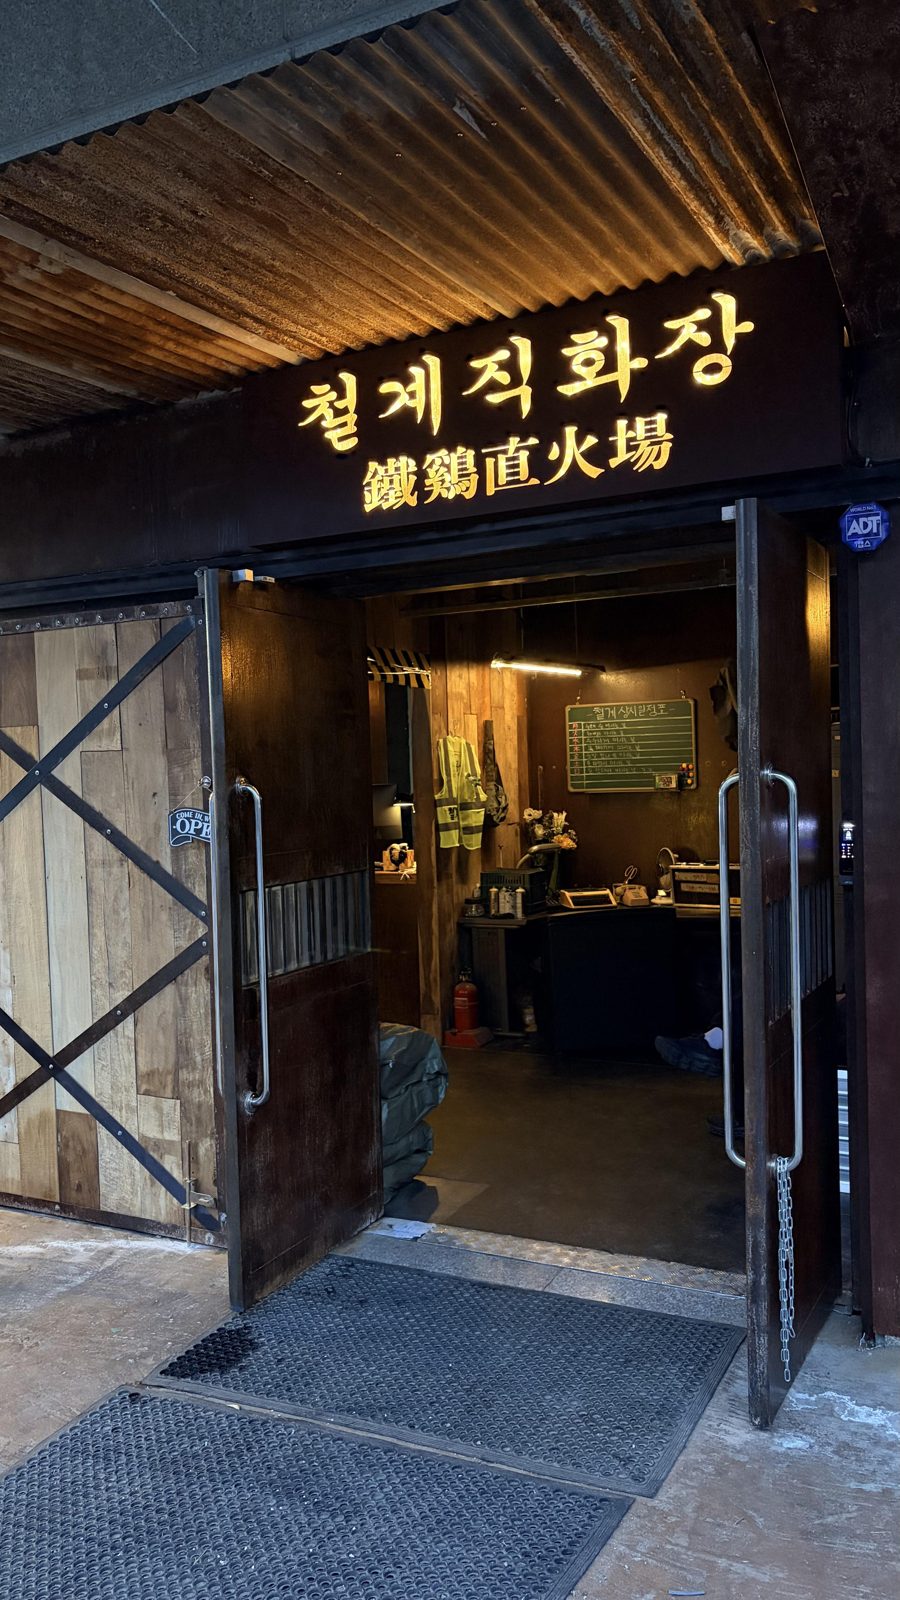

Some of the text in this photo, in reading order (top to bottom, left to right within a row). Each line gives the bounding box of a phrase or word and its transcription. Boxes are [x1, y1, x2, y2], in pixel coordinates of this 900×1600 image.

[847, 516, 881, 536] ADT
[176, 811, 194, 819] COME
[176, 818, 211, 838] OPE
